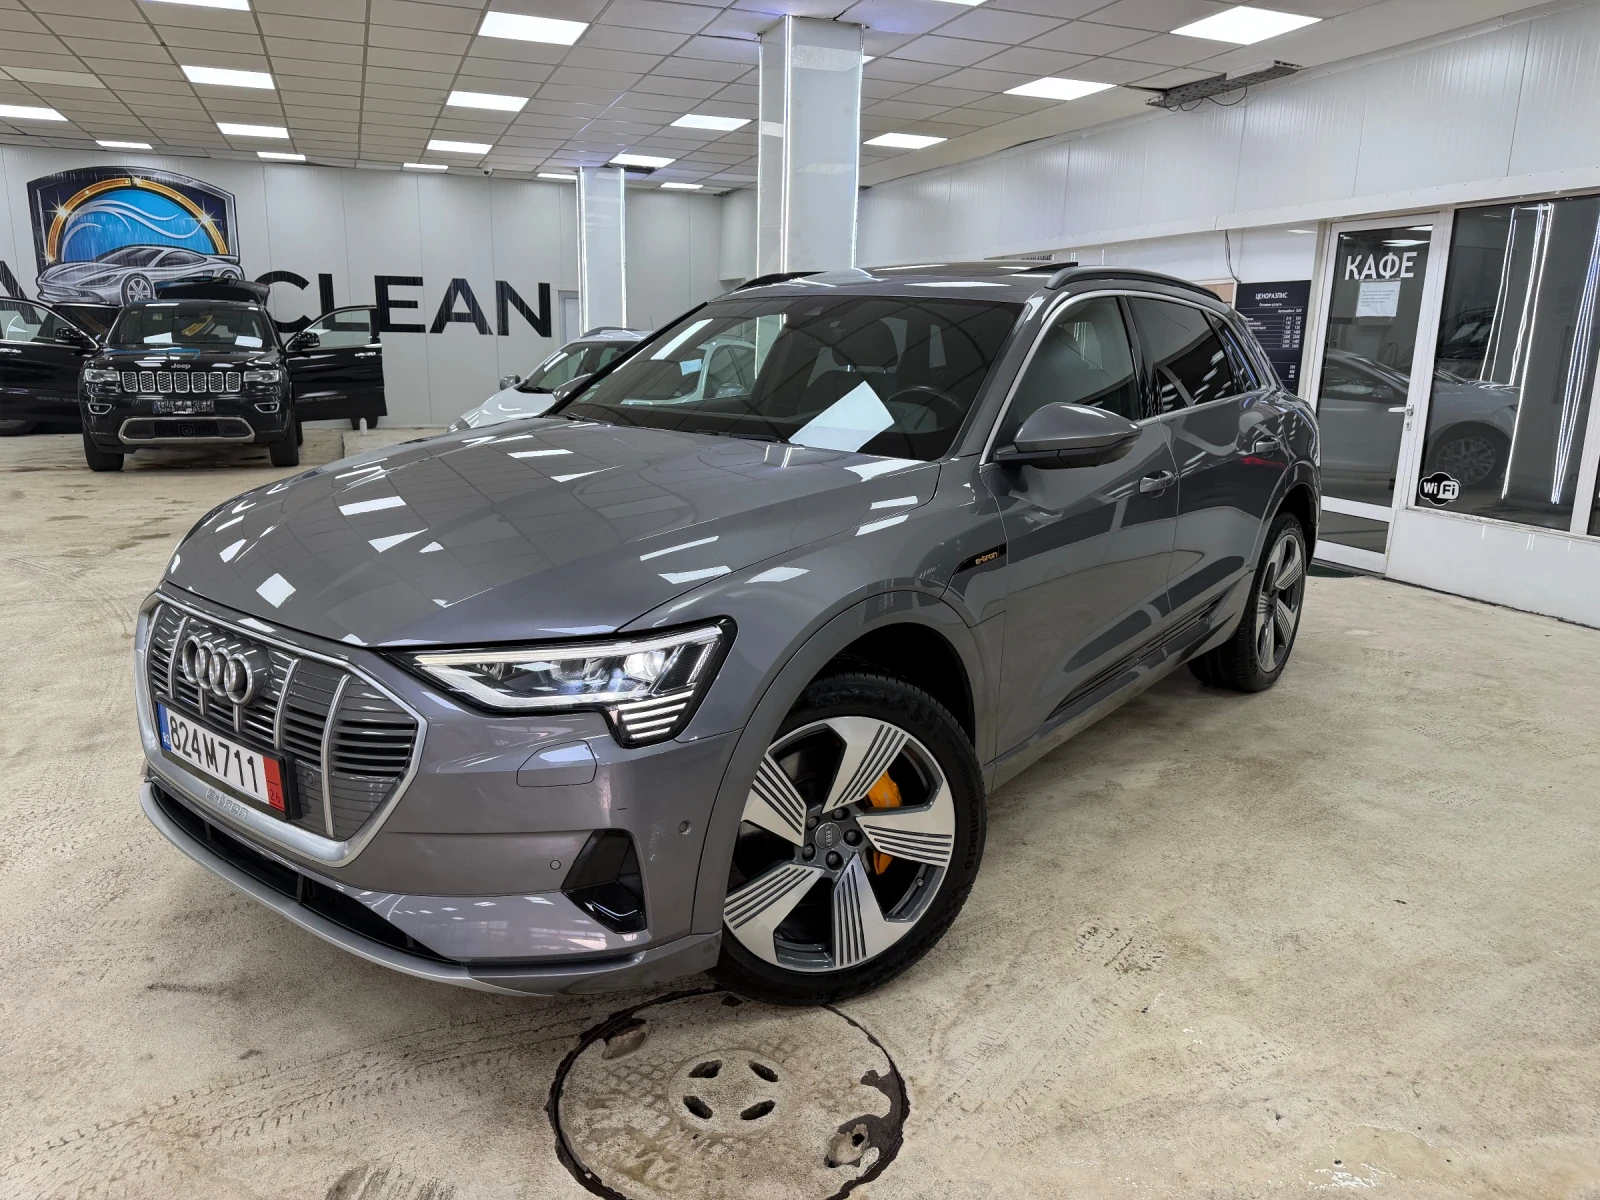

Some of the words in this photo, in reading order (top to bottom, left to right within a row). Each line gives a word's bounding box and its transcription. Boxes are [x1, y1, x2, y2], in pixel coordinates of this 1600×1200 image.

[1345, 251, 1418, 281] КАФЕ
[253, 270, 552, 338] CLEAN
[170, 715, 259, 794] 824M711
[205, 788, 249, 820] e-tron
